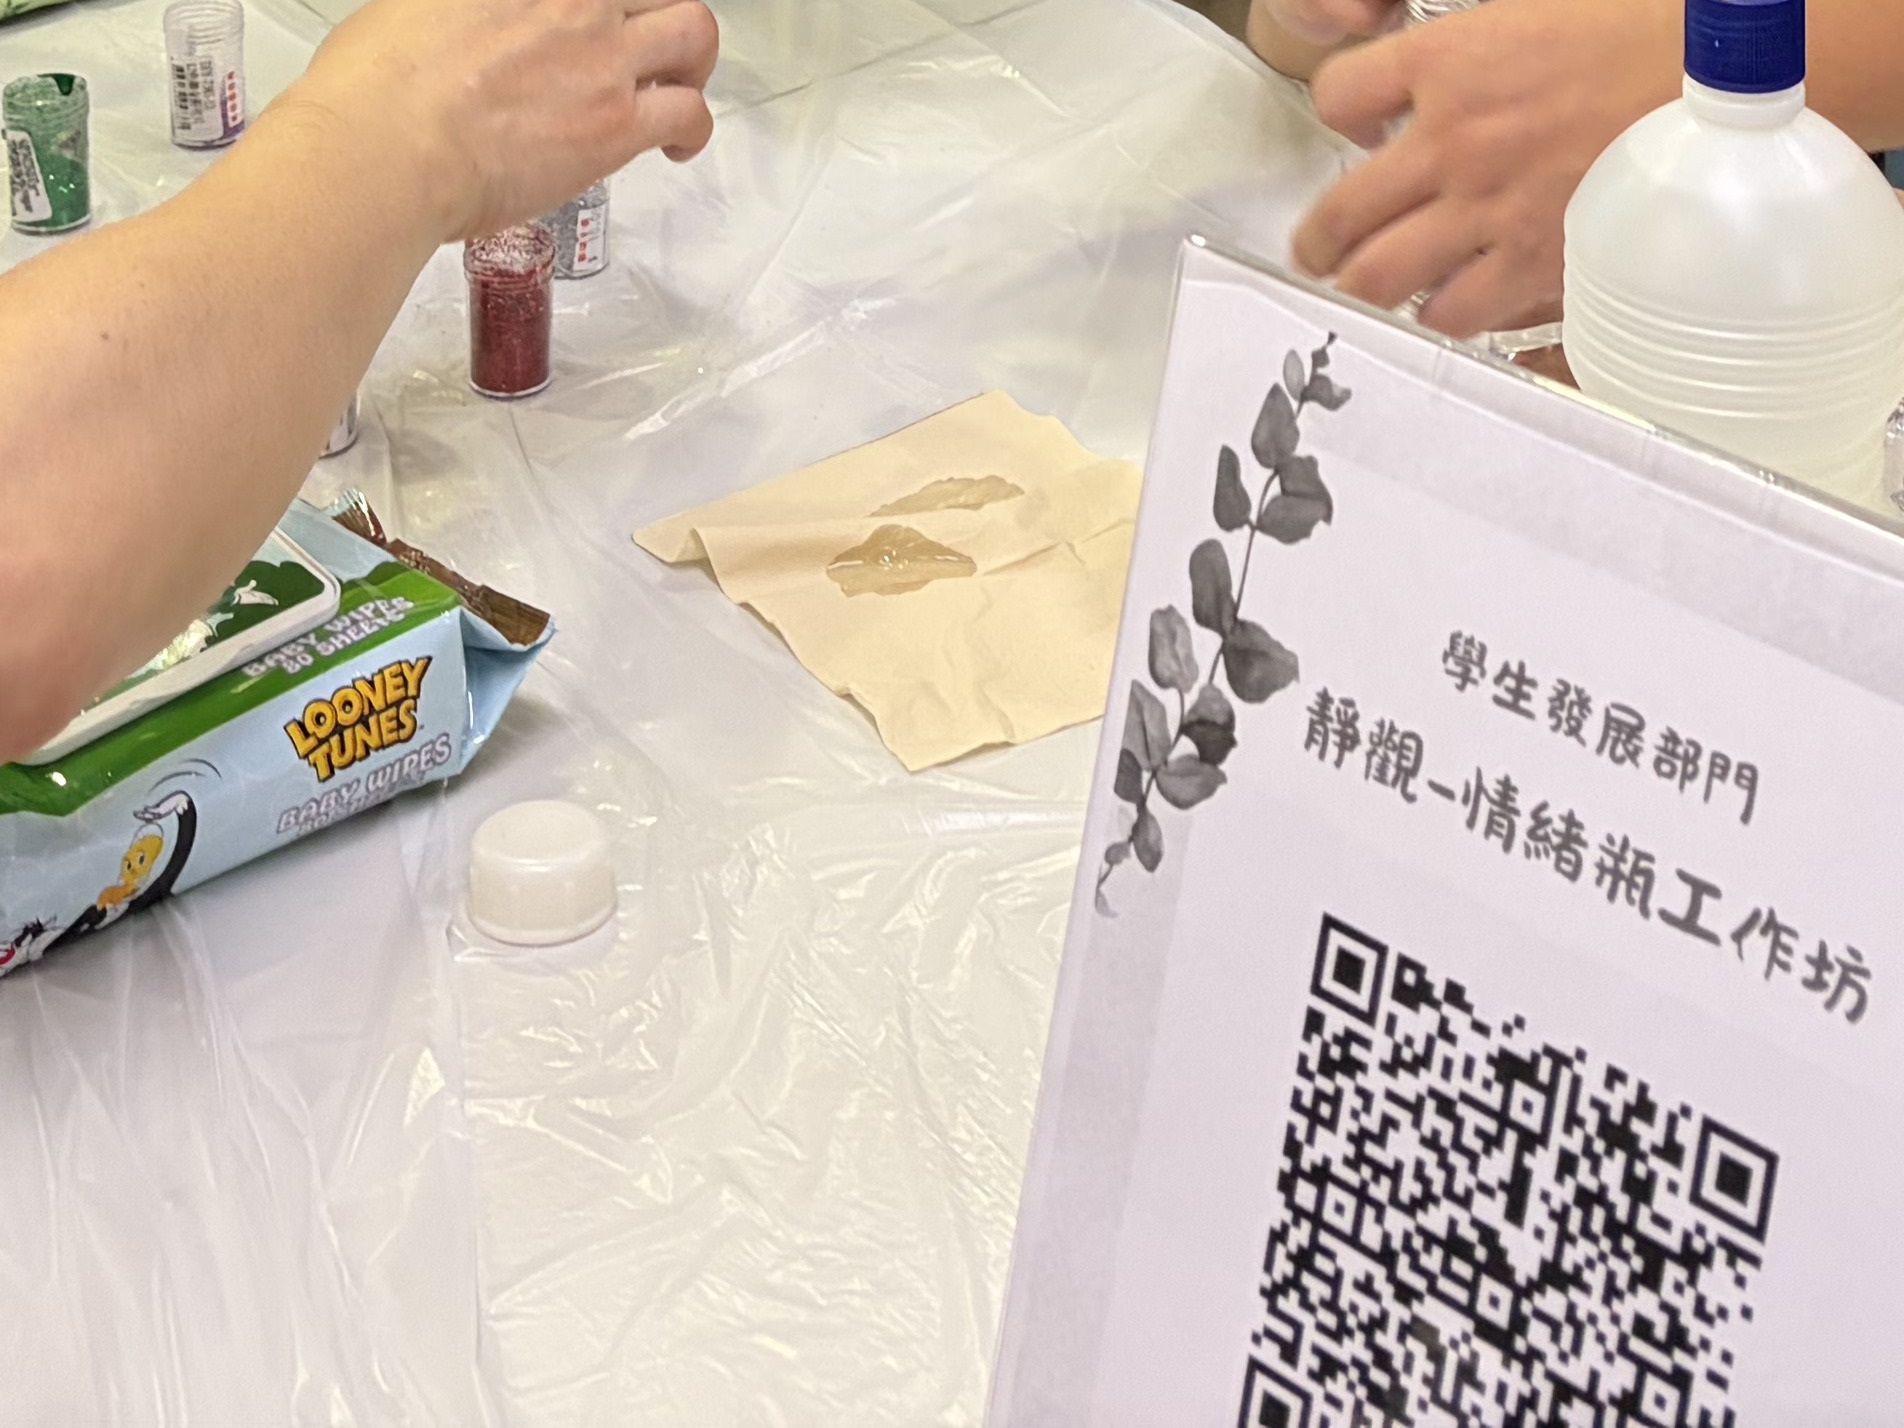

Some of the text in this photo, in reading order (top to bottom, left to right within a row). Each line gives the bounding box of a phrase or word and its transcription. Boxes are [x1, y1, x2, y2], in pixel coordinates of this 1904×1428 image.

[242, 596, 415, 676] BABY WIPES
[283, 655, 433, 760] LOONEY
[307, 699, 419, 783] TUNES
[1441, 630, 1760, 826] 學生發展部門
[276, 778, 361, 834] BABY
[366, 732, 452, 793] WIPES
